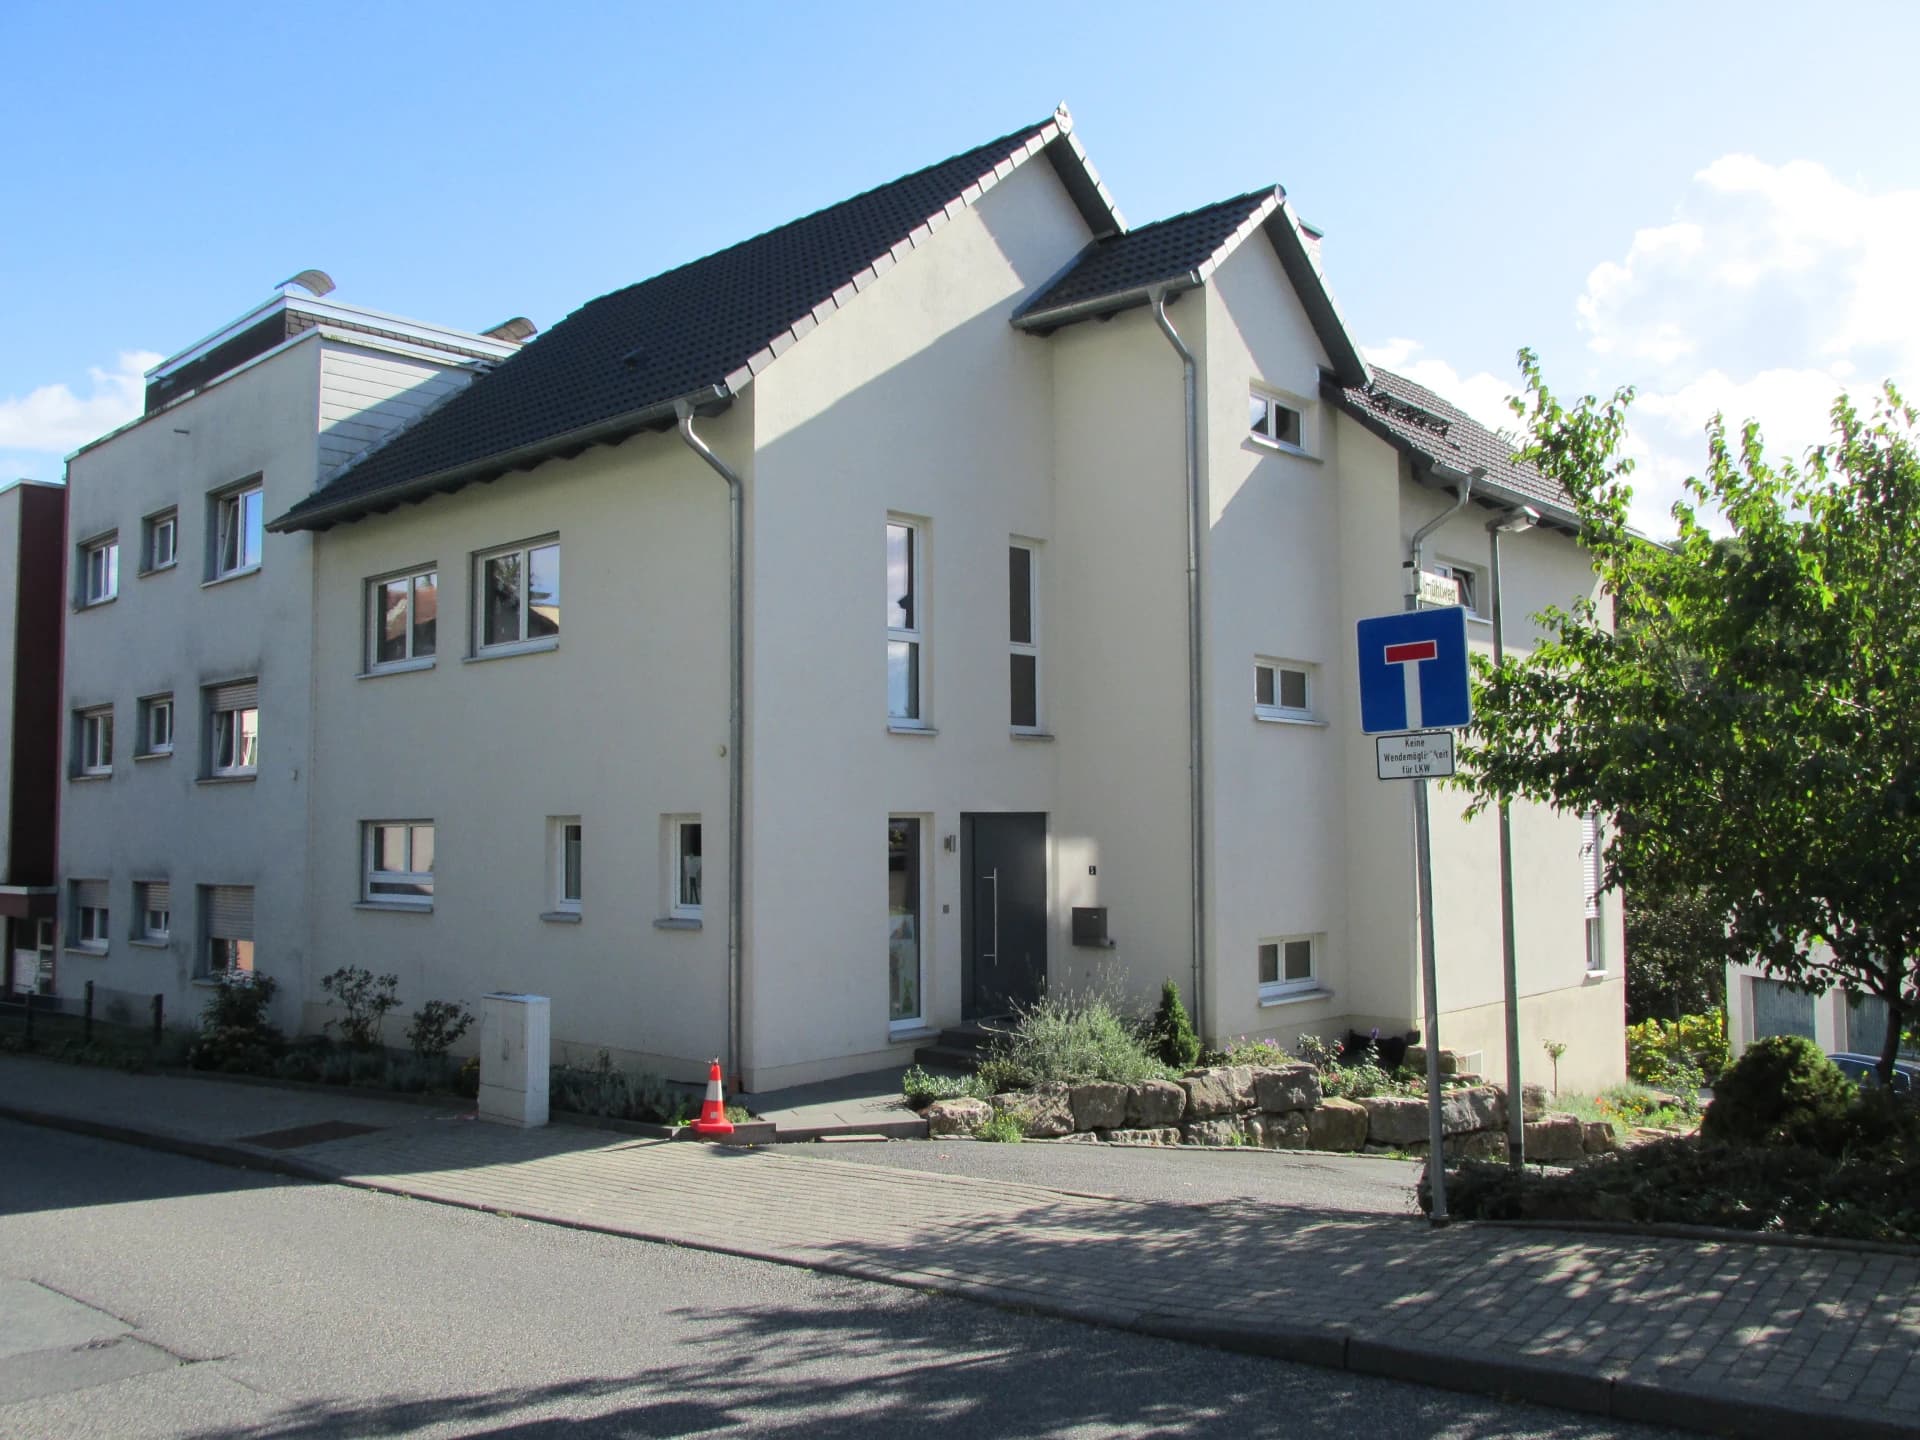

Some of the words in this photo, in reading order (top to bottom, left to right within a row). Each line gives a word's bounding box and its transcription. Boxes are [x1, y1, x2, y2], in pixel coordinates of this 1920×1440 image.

[1405, 738, 1425, 748] Keine
[1402, 765, 1413, 774] für
[1414, 764, 1431, 774] LKW
